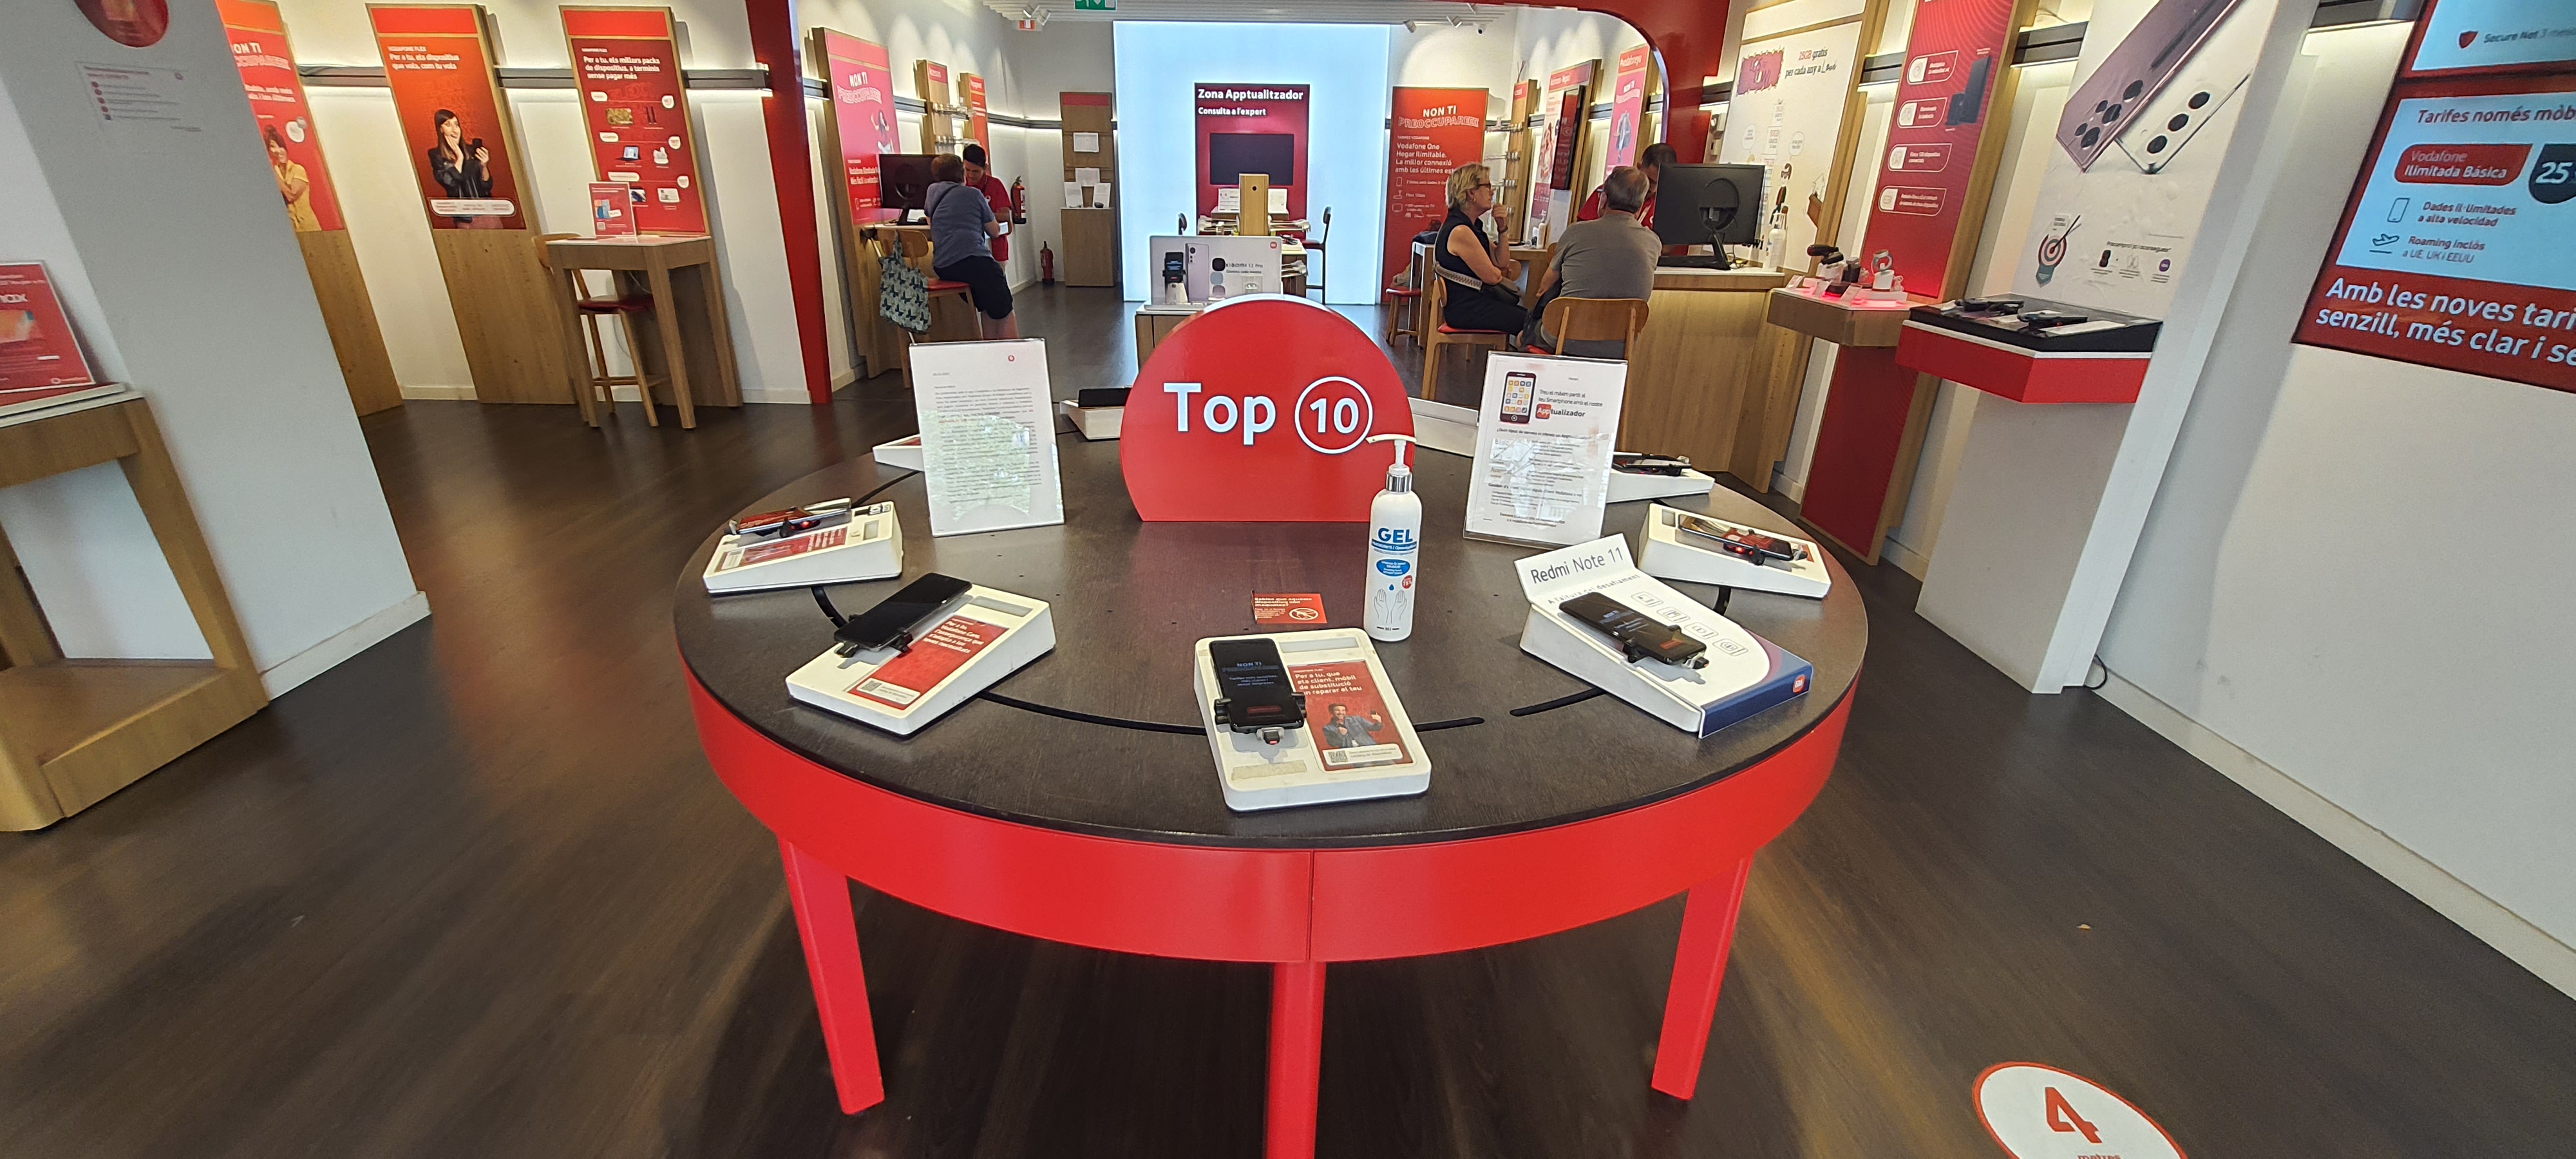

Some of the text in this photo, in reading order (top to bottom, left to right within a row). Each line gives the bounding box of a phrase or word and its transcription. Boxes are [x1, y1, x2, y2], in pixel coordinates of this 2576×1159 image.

[849, 71, 867, 87] NON TI
[1785, 69, 1793, 79] per
[1197, 88, 1304, 102] Zona Apptualitzador
[1198, 106, 1231, 115] Consulta
[1236, 107, 1267, 117] l'expert
[1423, 105, 1457, 118] NON TI
[2417, 104, 2576, 124] Tarifes només mòb
[2410, 150, 2468, 162] Vodafone
[2404, 164, 2508, 178] Ilimitada Básica
[2422, 201, 2454, 212] Dades
[2425, 213, 2446, 223] alta
[2447, 216, 2499, 227] velocidad
[2407, 235, 2452, 250] Roaming
[2426, 250, 2441, 260] UK
[2447, 251, 2475, 263] EEUU
[2325, 277, 2383, 304] Amb
[2387, 283, 2428, 310] les
[2429, 294, 2518, 323] noves
[2315, 308, 2400, 339] senzill,
[2406, 320, 2466, 347] més
[2469, 328, 2530, 356] clar
[2530, 335, 2548, 359] i
[1163, 382, 1359, 446] Top 10
[1378, 527, 1414, 543] GEL
[1530, 547, 1624, 584] Redmi Note 11
[1310, 681, 1352, 690] substitució
[2045, 1086, 2103, 1144] 4
